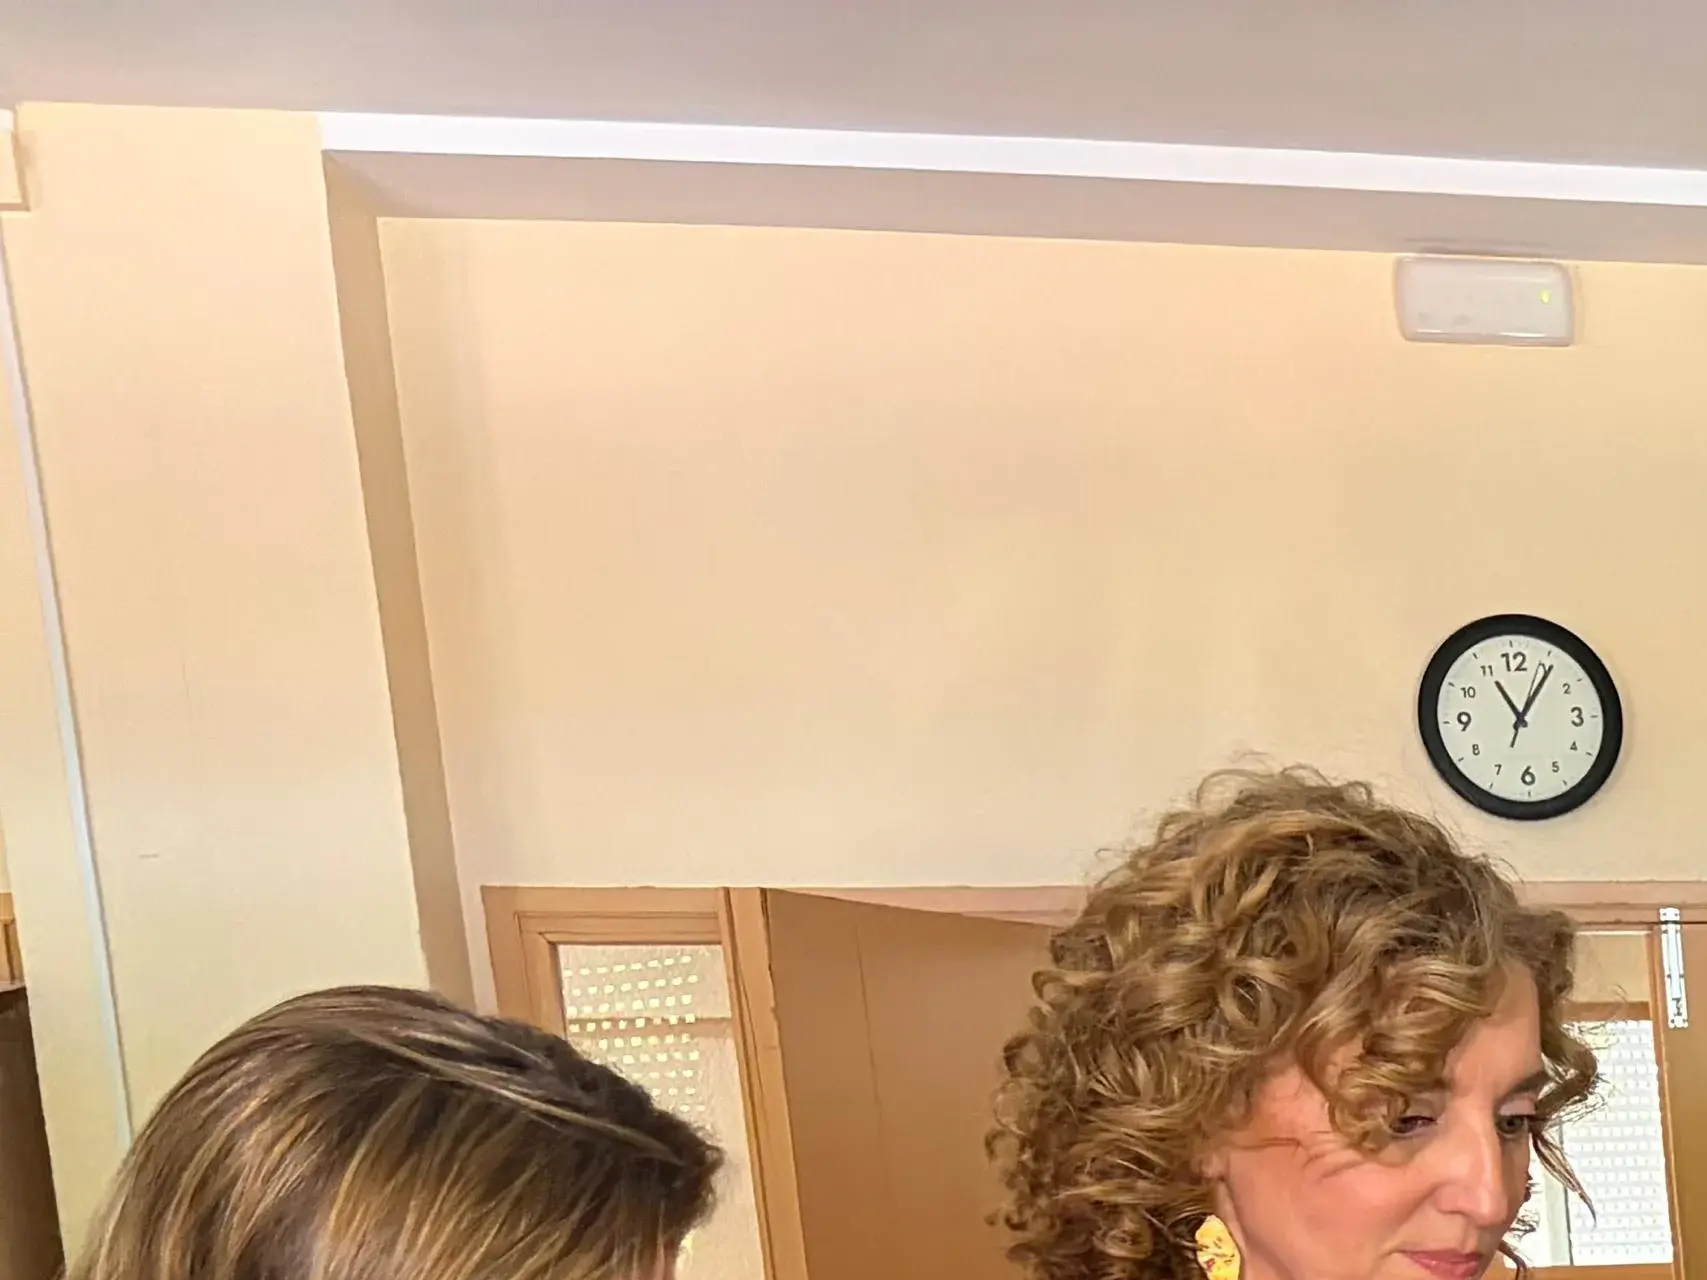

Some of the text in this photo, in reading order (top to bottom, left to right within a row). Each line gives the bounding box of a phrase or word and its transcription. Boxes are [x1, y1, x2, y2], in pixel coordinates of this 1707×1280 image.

[1500, 651, 1528, 672] 12
[1479, 664, 1494, 677] 11
[1460, 685, 1476, 699] 10
[1562, 682, 1571, 695] 2
[1456, 711, 1472, 732] 9
[1570, 706, 1585, 728] 3
[1472, 743, 1480, 756] 8
[1569, 740, 1578, 752] 4
[1494, 763, 1503, 775] 7
[1551, 760, 1560, 773] 5
[1520, 765, 1536, 786] 6
